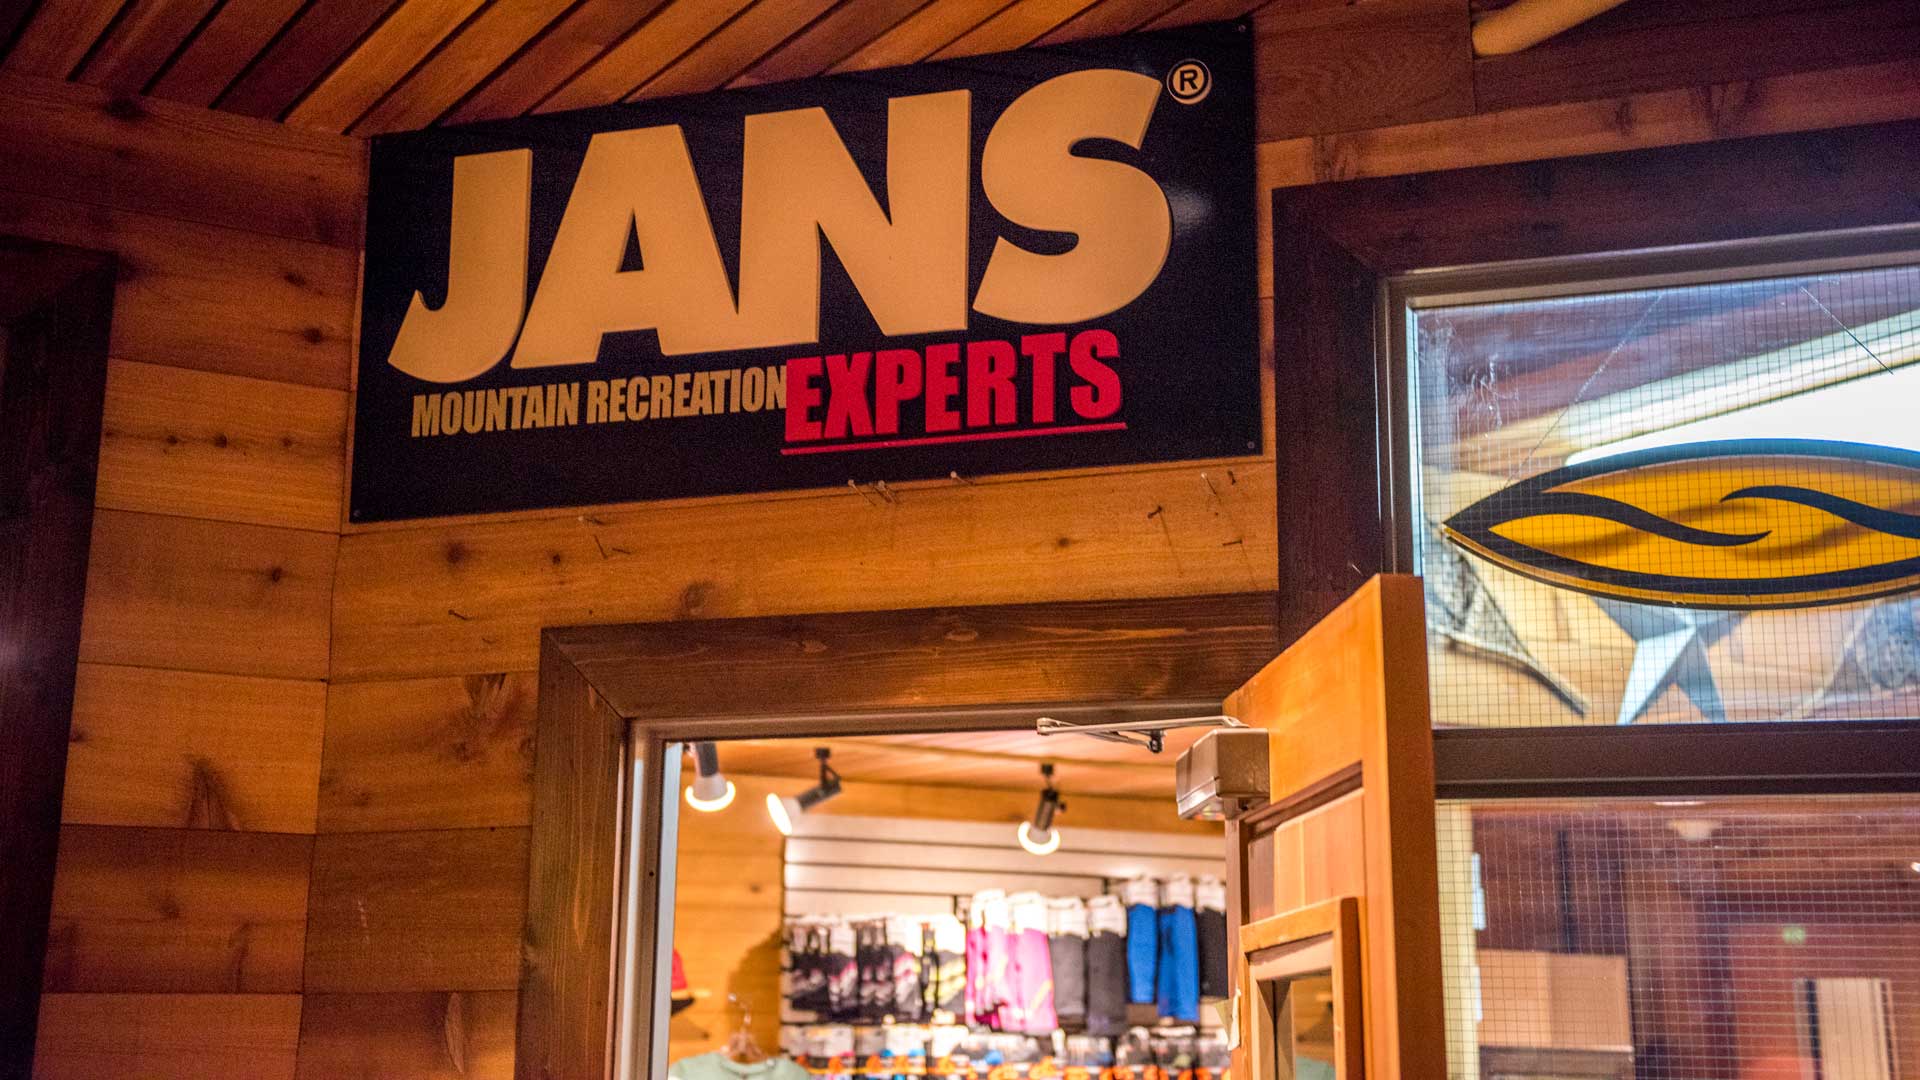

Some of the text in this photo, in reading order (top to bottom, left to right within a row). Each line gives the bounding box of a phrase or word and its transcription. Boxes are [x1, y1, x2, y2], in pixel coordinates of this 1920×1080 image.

[388, 69, 1173, 383] JANS
[411, 329, 1122, 442] MOUNTAIN RECREATION EXPERTS
